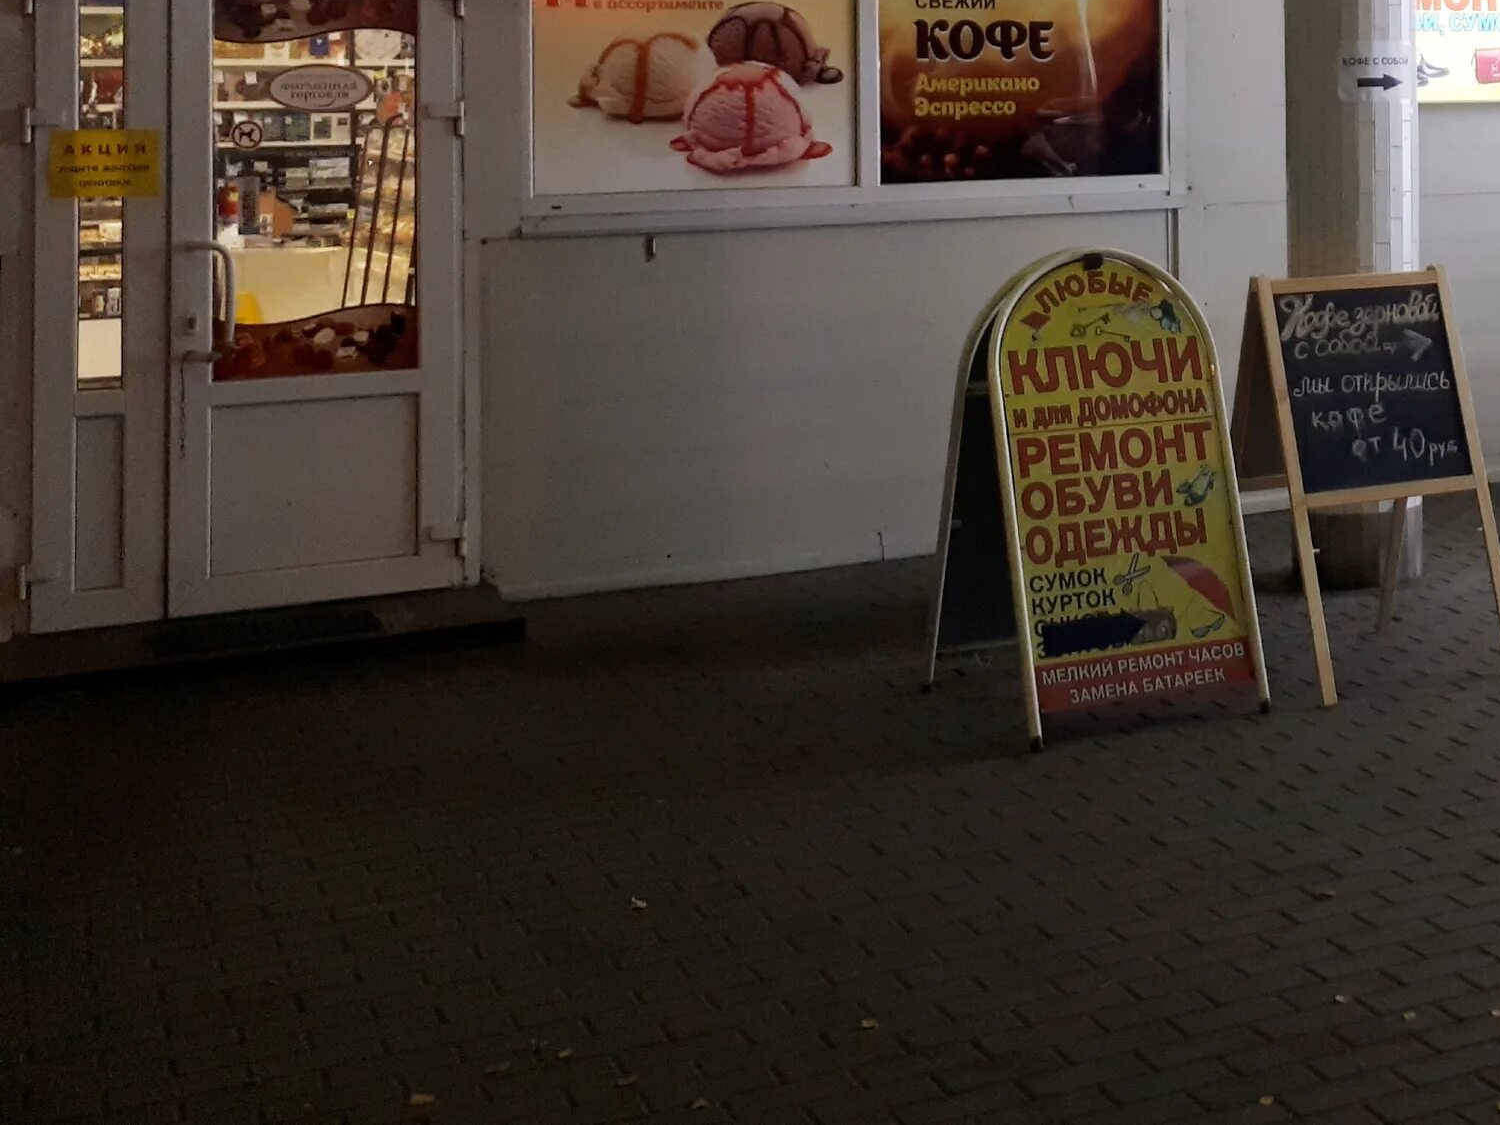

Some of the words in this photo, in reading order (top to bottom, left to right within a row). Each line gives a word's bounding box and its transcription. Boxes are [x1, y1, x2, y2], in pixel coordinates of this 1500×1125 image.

[912, 18, 1056, 62] КОФЕ
[915, 73, 1041, 98] Американо
[914, 96, 1017, 120] Эспрессо
[1034, 270, 1154, 315] ЛЮБЫЕ
[1008, 336, 1203, 395] КЛЮЧИ
[1341, 370, 1451, 403] открылись
[1077, 387, 1208, 429] ДОМОФОНА
[1017, 423, 1212, 479] РЕМОНТ
[1392, 427, 1426, 462] 40
[1021, 470, 1174, 521] ОБУВИ
[1025, 508, 1208, 569] ОДЕЖДЫ
[1029, 567, 1108, 594] СУМОК
[1032, 588, 1116, 616] КУРТОК
[1041, 659, 1115, 686] МЕЛКИЙ
[1118, 650, 1185, 675] РЕМОНТ
[1188, 642, 1245, 664] ЧАСОВ
[1070, 681, 1139, 705] ЗАМЕНА
[1143, 667, 1226, 693] БАТАРЕЕК
